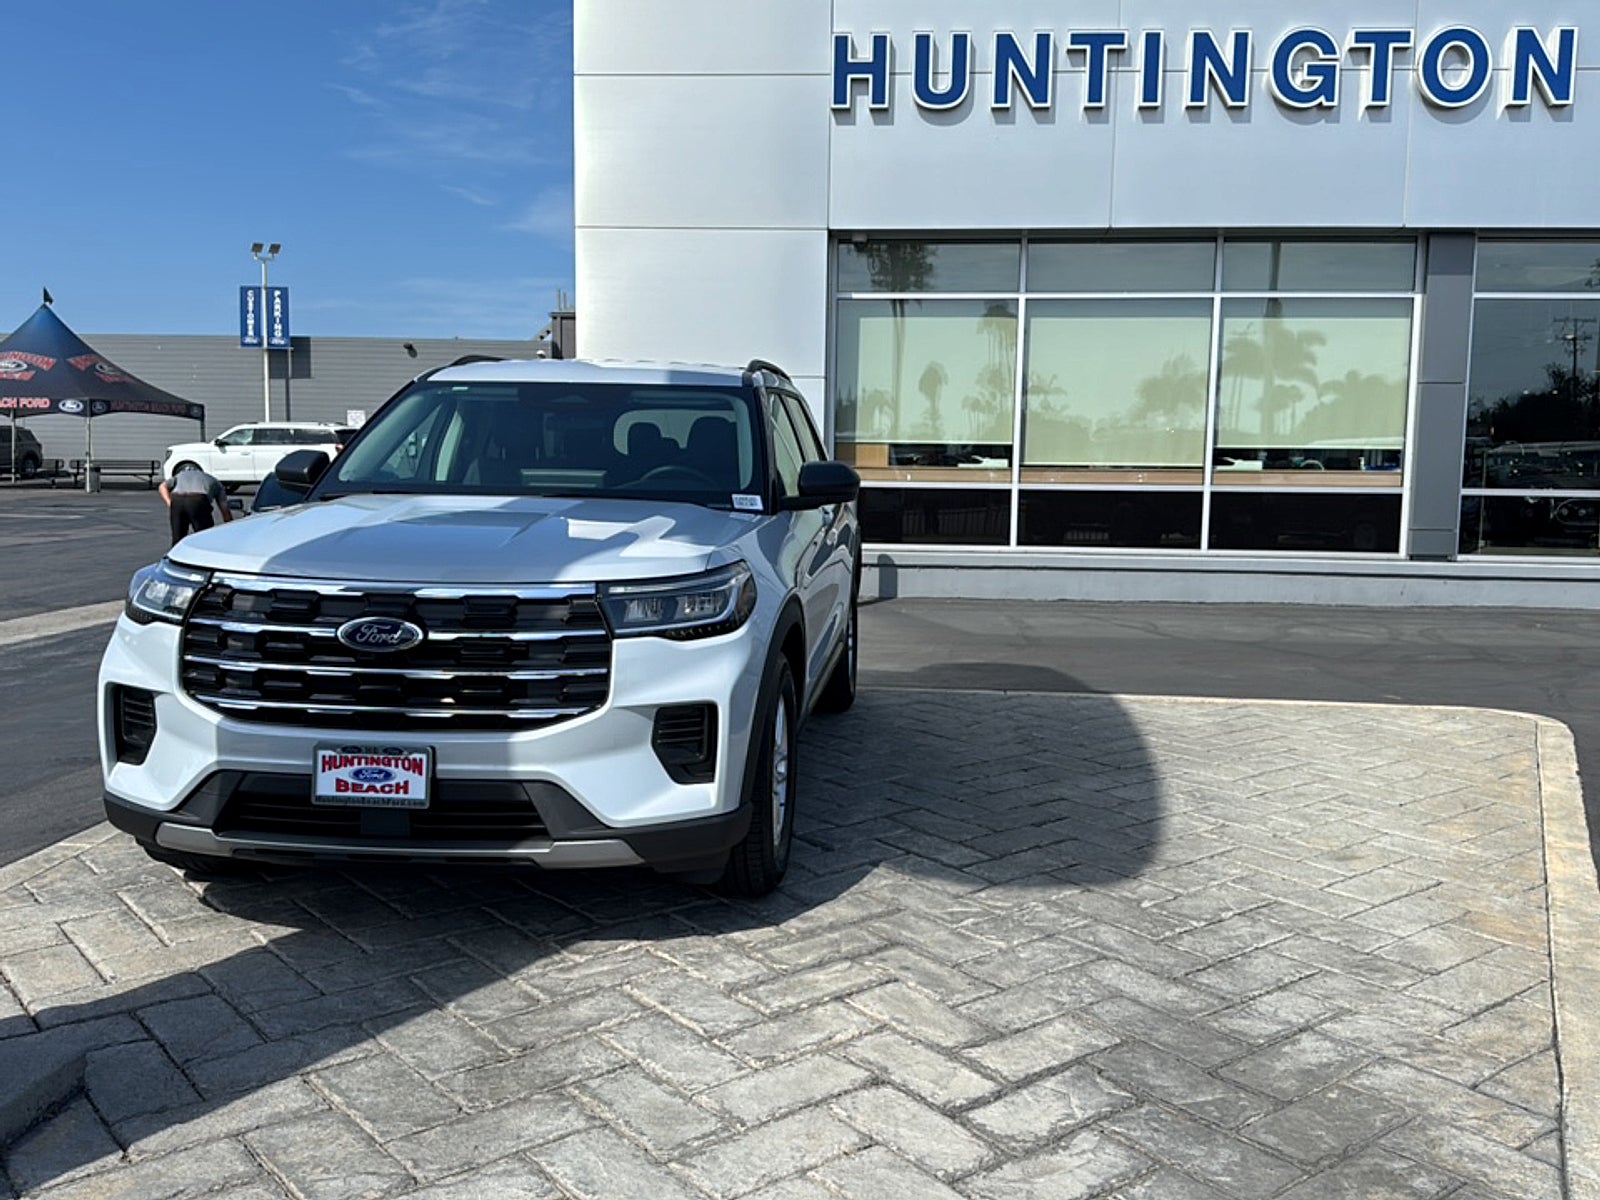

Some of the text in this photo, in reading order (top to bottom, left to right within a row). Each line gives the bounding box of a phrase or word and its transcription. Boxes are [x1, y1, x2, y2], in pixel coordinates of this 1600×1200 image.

[832, 27, 1578, 110] HUNTINGTON
[246, 289, 254, 337] CUSTOMER
[273, 289, 282, 337] PARKING
[19, 397, 51, 409] FORD
[355, 623, 403, 644] Ford
[321, 754, 424, 776] HUNTINGTON
[358, 768, 386, 780] Ford
[335, 778, 410, 795] BEACH
